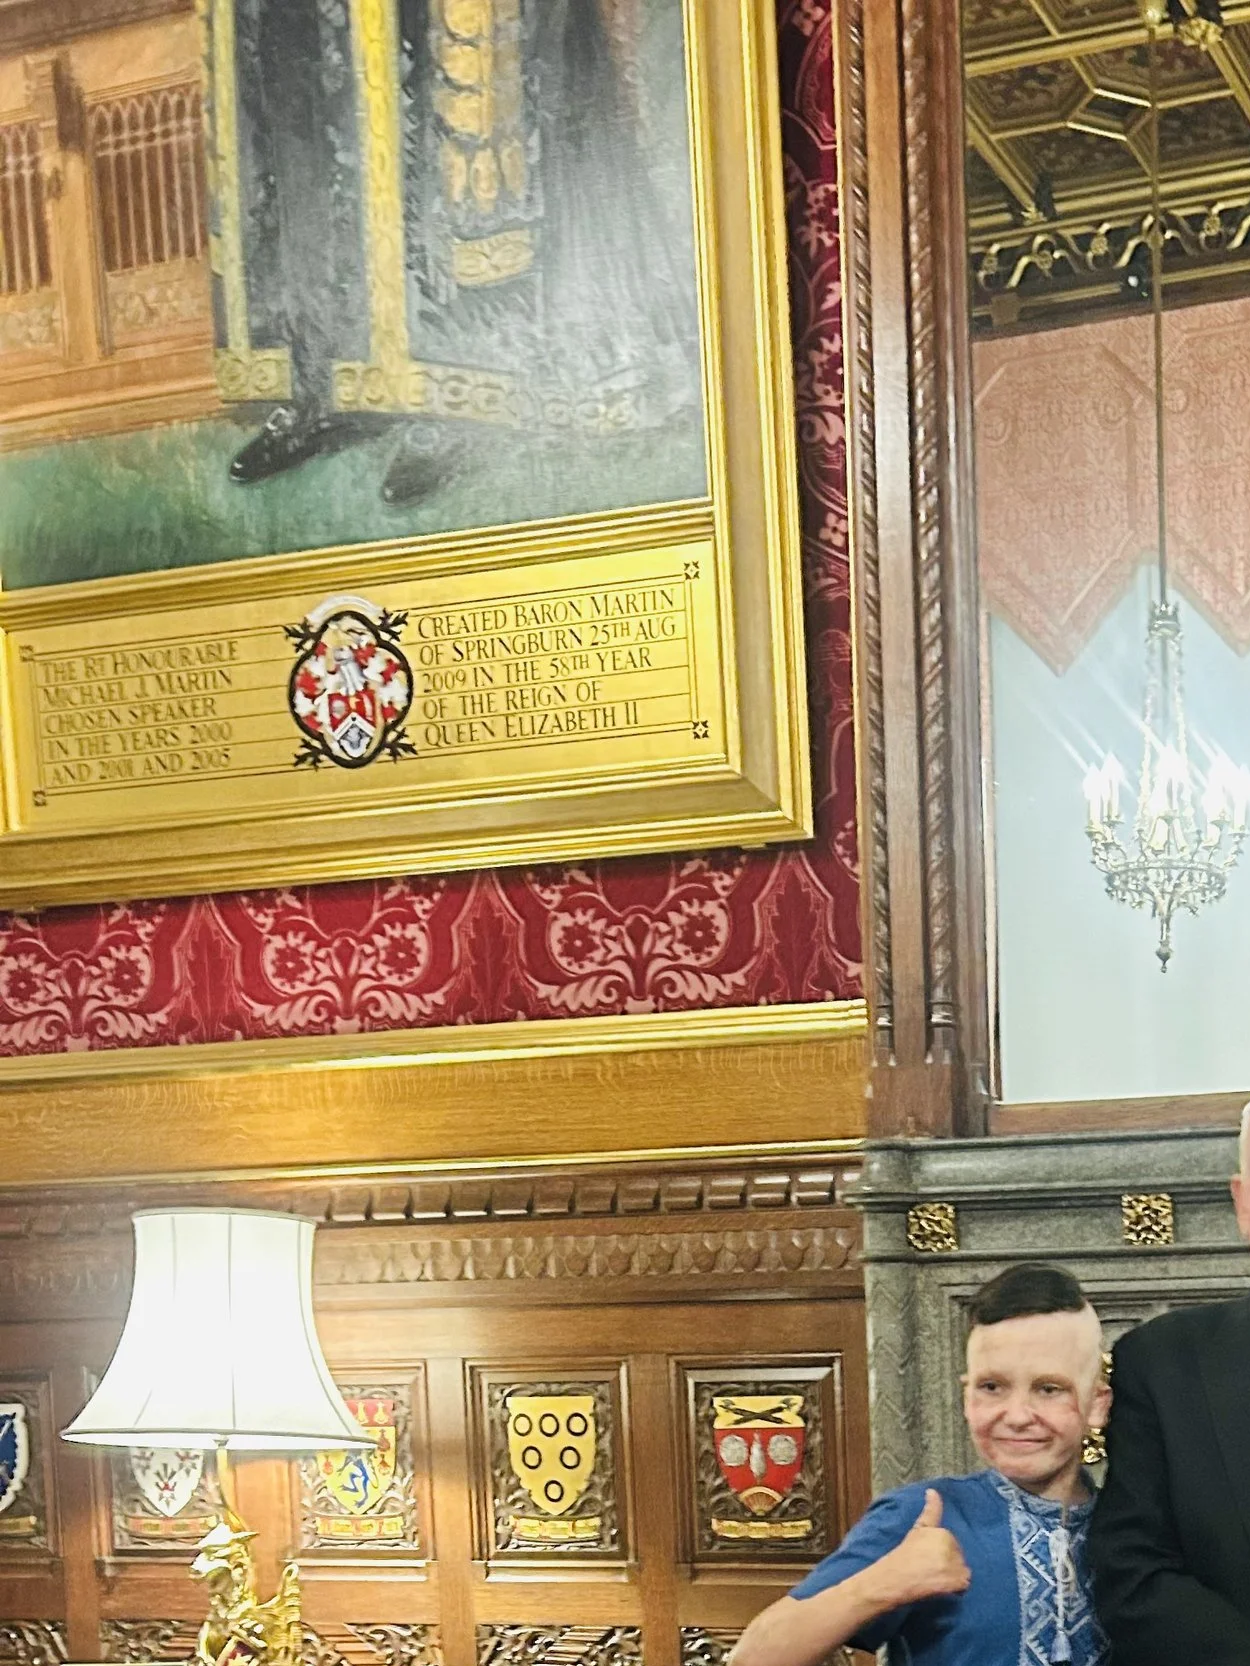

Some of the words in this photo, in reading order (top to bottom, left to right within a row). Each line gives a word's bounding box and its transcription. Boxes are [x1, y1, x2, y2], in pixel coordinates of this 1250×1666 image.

[418, 609, 507, 639] CREATED
[515, 599, 583, 628] BARON
[591, 588, 675, 618] MARTIN
[42, 661, 77, 684] THE
[112, 640, 239, 675] HONOURABLE
[420, 643, 445, 666] OF
[452, 627, 583, 664] SPRINGBURN
[635, 616, 676, 642] AUG
[44, 681, 125, 707] MICHAEL
[155, 669, 232, 695] MARTIN
[423, 669, 467, 694] 2009
[474, 665, 494, 687] IN
[505, 660, 542, 684] THE
[597, 647, 652, 673] YEAR
[45, 709, 121, 734] CHOSEN
[128, 697, 217, 725] SPEAKER
[423, 696, 449, 720] OF
[458, 692, 498, 716] THE
[506, 684, 567, 711] REIGN
[576, 680, 604, 702] OF
[48, 740, 69, 761] IN
[76, 734, 112, 757] THE
[118, 726, 182, 752] YEARS
[425, 720, 496, 747] QUEEN
[505, 705, 617, 739] ELIZABETH
[625, 701, 640, 726] II
[52, 763, 92, 785] AND
[143, 753, 183, 775] AND
